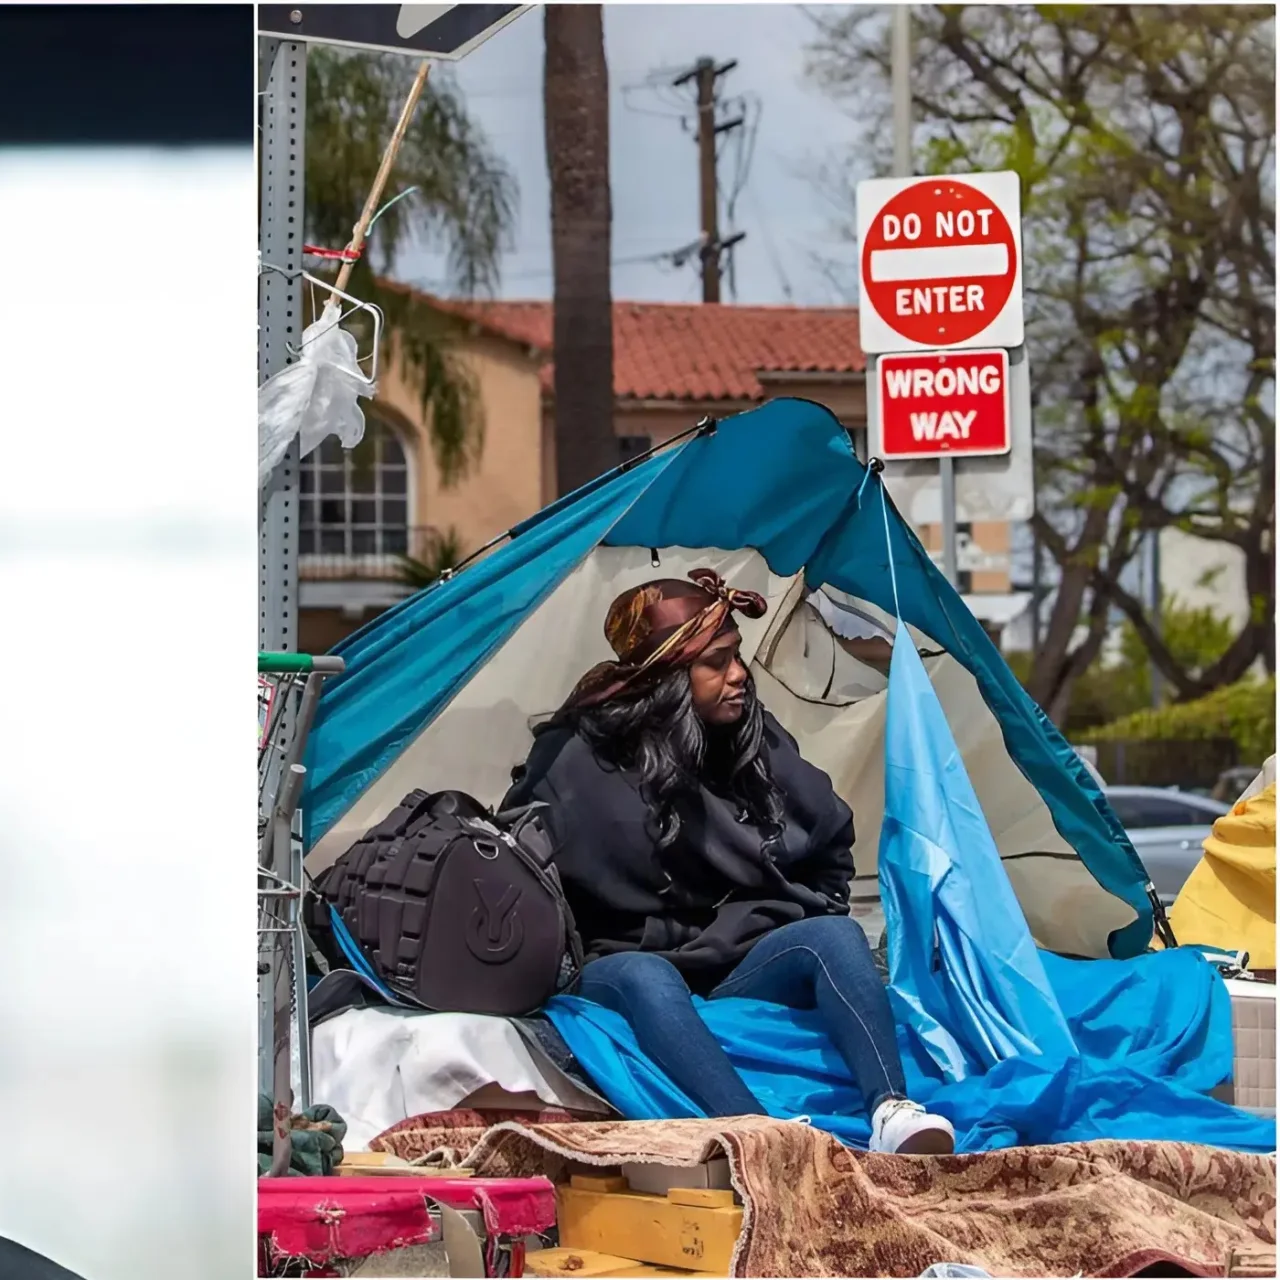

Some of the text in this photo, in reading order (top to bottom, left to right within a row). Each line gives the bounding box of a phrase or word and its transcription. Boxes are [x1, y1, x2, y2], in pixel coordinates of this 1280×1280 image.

[882, 208, 994, 242] DO NOT
[895, 284, 985, 316] ENTER
[885, 365, 1001, 399] WRONG
[909, 409, 978, 442] WAY
